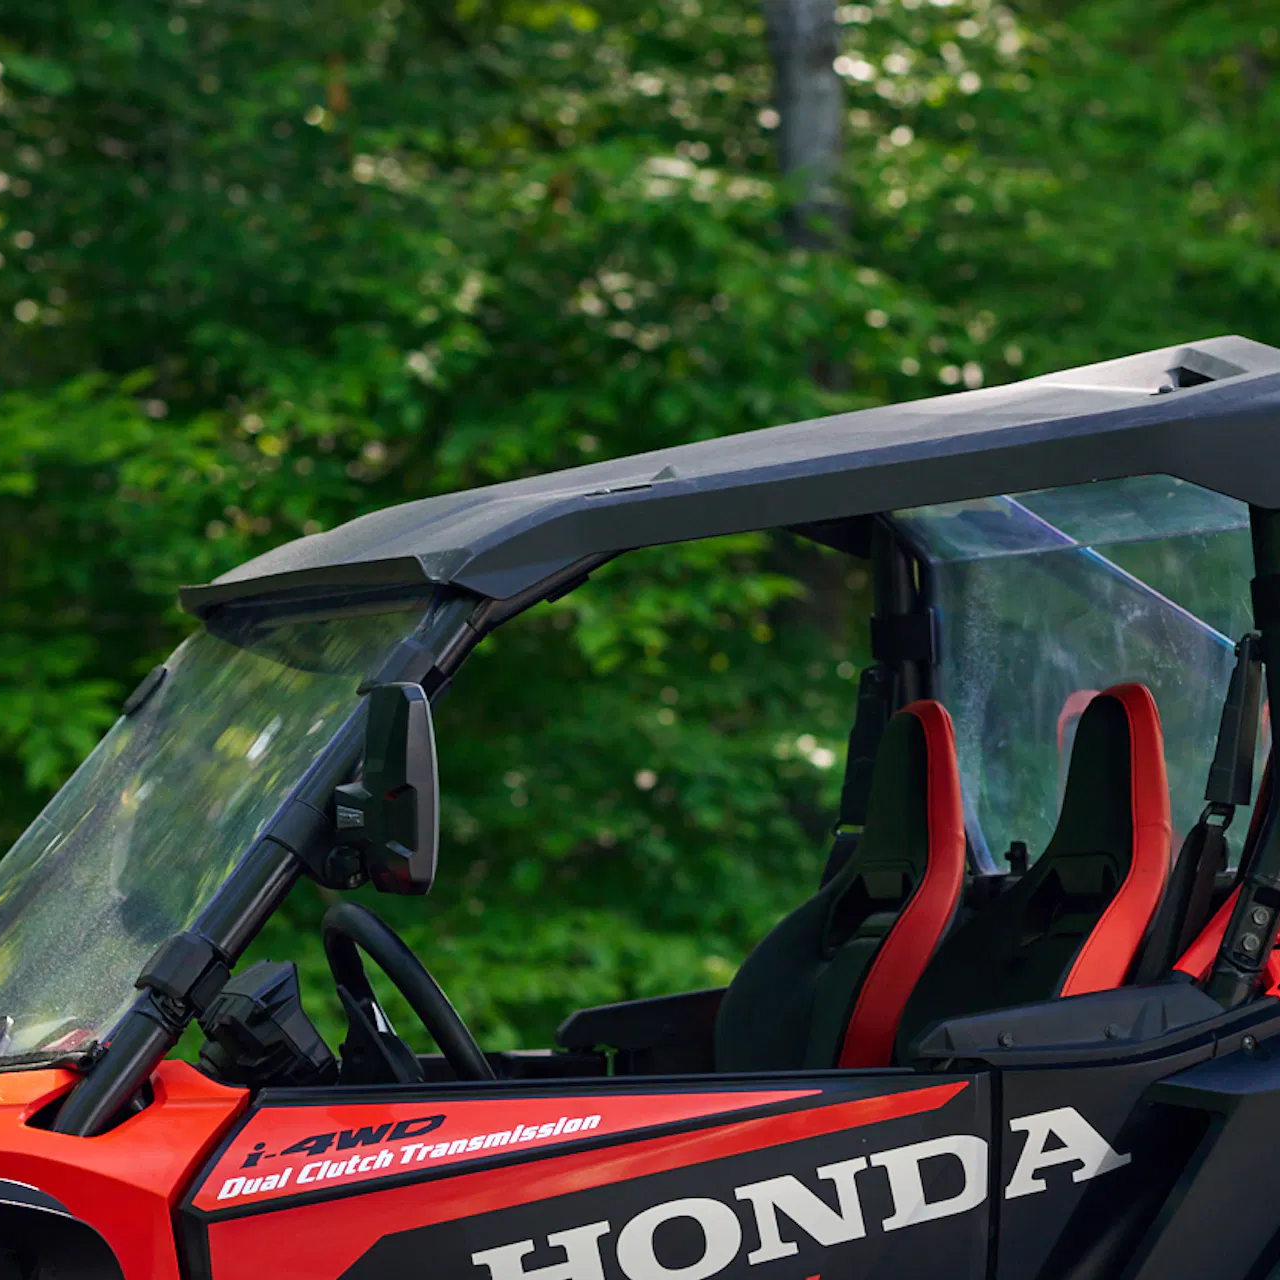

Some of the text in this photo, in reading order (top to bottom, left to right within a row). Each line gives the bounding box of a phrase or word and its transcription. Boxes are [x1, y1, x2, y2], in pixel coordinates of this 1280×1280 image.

[217, 1114, 601, 1200] Dual Clutch Transmission
[240, 1114, 447, 1169] i-4WD
